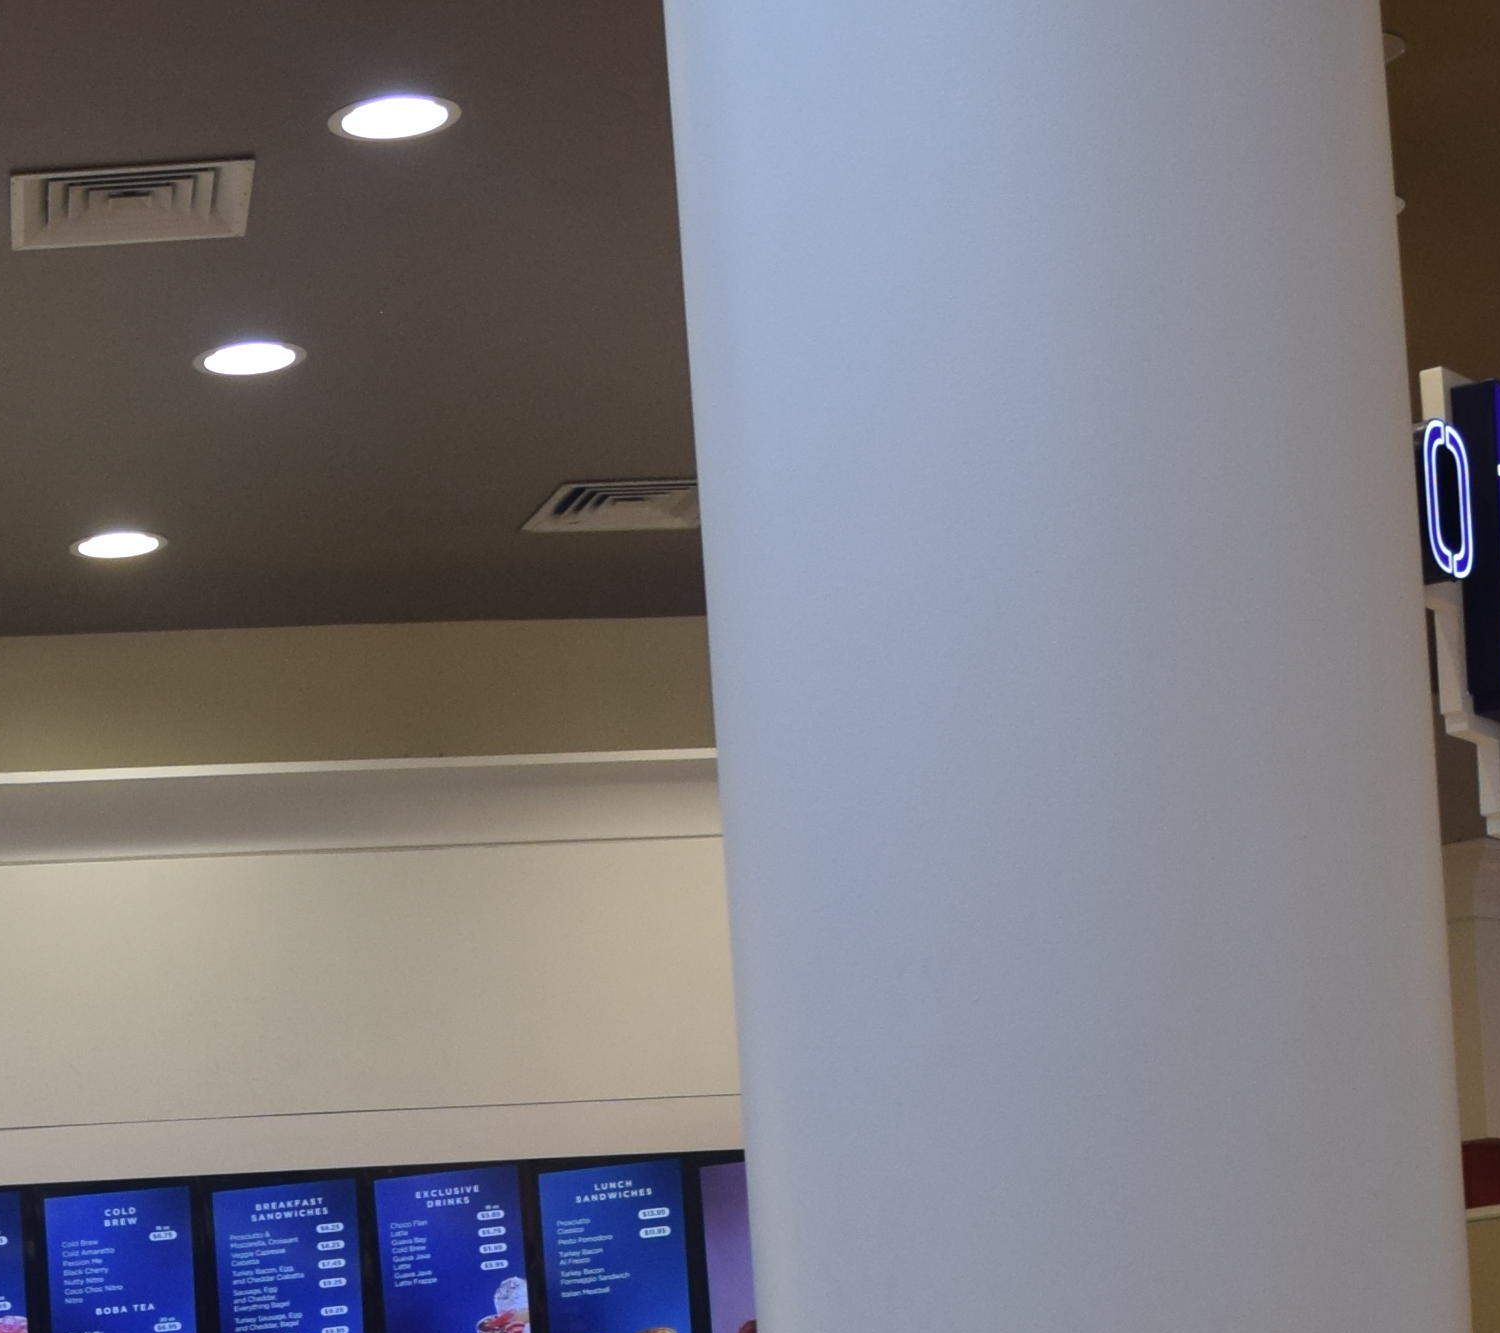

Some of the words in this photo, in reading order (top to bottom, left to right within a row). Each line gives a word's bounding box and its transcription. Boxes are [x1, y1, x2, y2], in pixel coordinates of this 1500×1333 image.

[594, 1180, 632, 1191] LUNCH
[415, 1185, 479, 1199] EXCLUSIVE
[576, 1188, 652, 1203] SANDWICHES
[256, 1197, 323, 1211] BREAKFAST
[427, 1197, 470, 1208] DRINKS
[104, 1207, 136, 1216] COLD
[251, 1207, 328, 1222] SANDWICHES
[104, 1217, 137, 1227] BREW
[96, 1305, 128, 1315] BOBA
[133, 1304, 155, 1312] TEA
